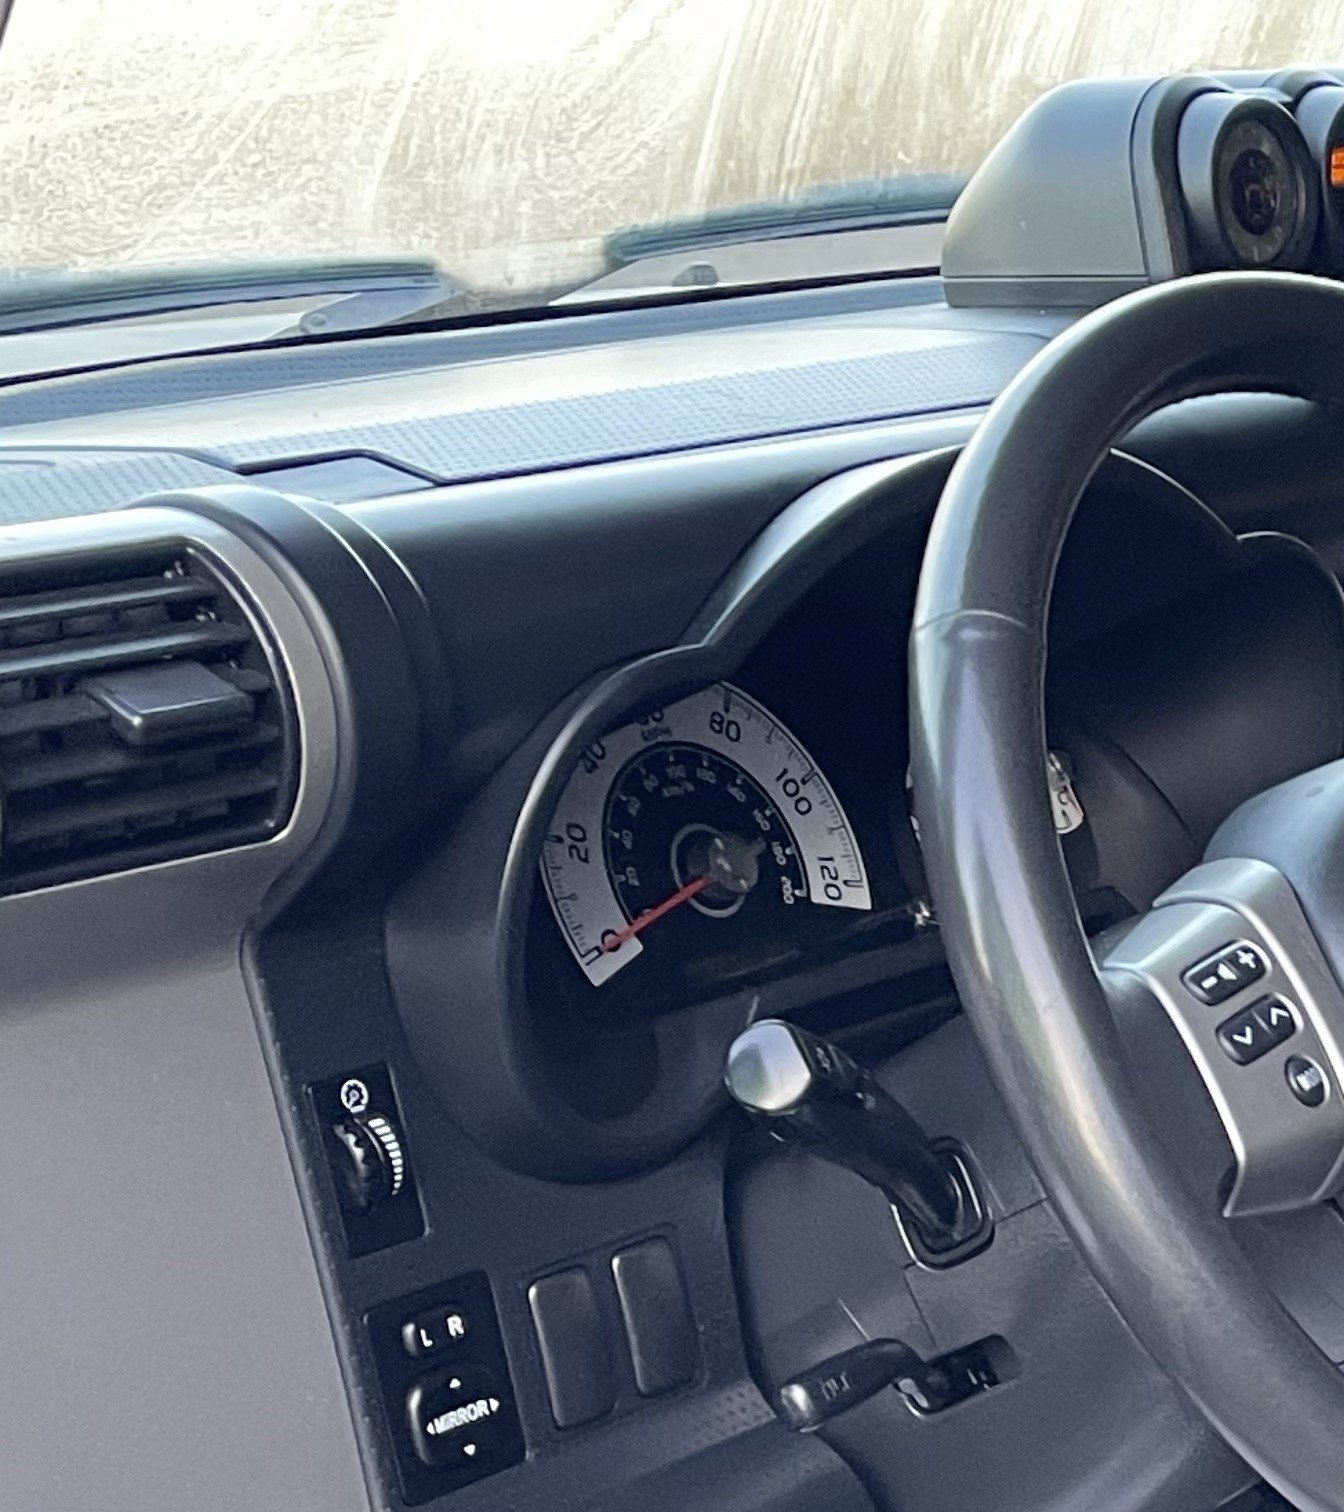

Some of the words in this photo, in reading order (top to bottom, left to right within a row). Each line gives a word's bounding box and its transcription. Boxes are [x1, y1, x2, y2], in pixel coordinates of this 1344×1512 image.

[709, 711, 741, 743] 80
[775, 767, 812, 816] 100
[566, 822, 590, 865] 20
[817, 856, 842, 901] 120
[420, 1328, 433, 1348] L
[446, 1315, 464, 1337] R
[433, 1399, 490, 1434] MIRROR
